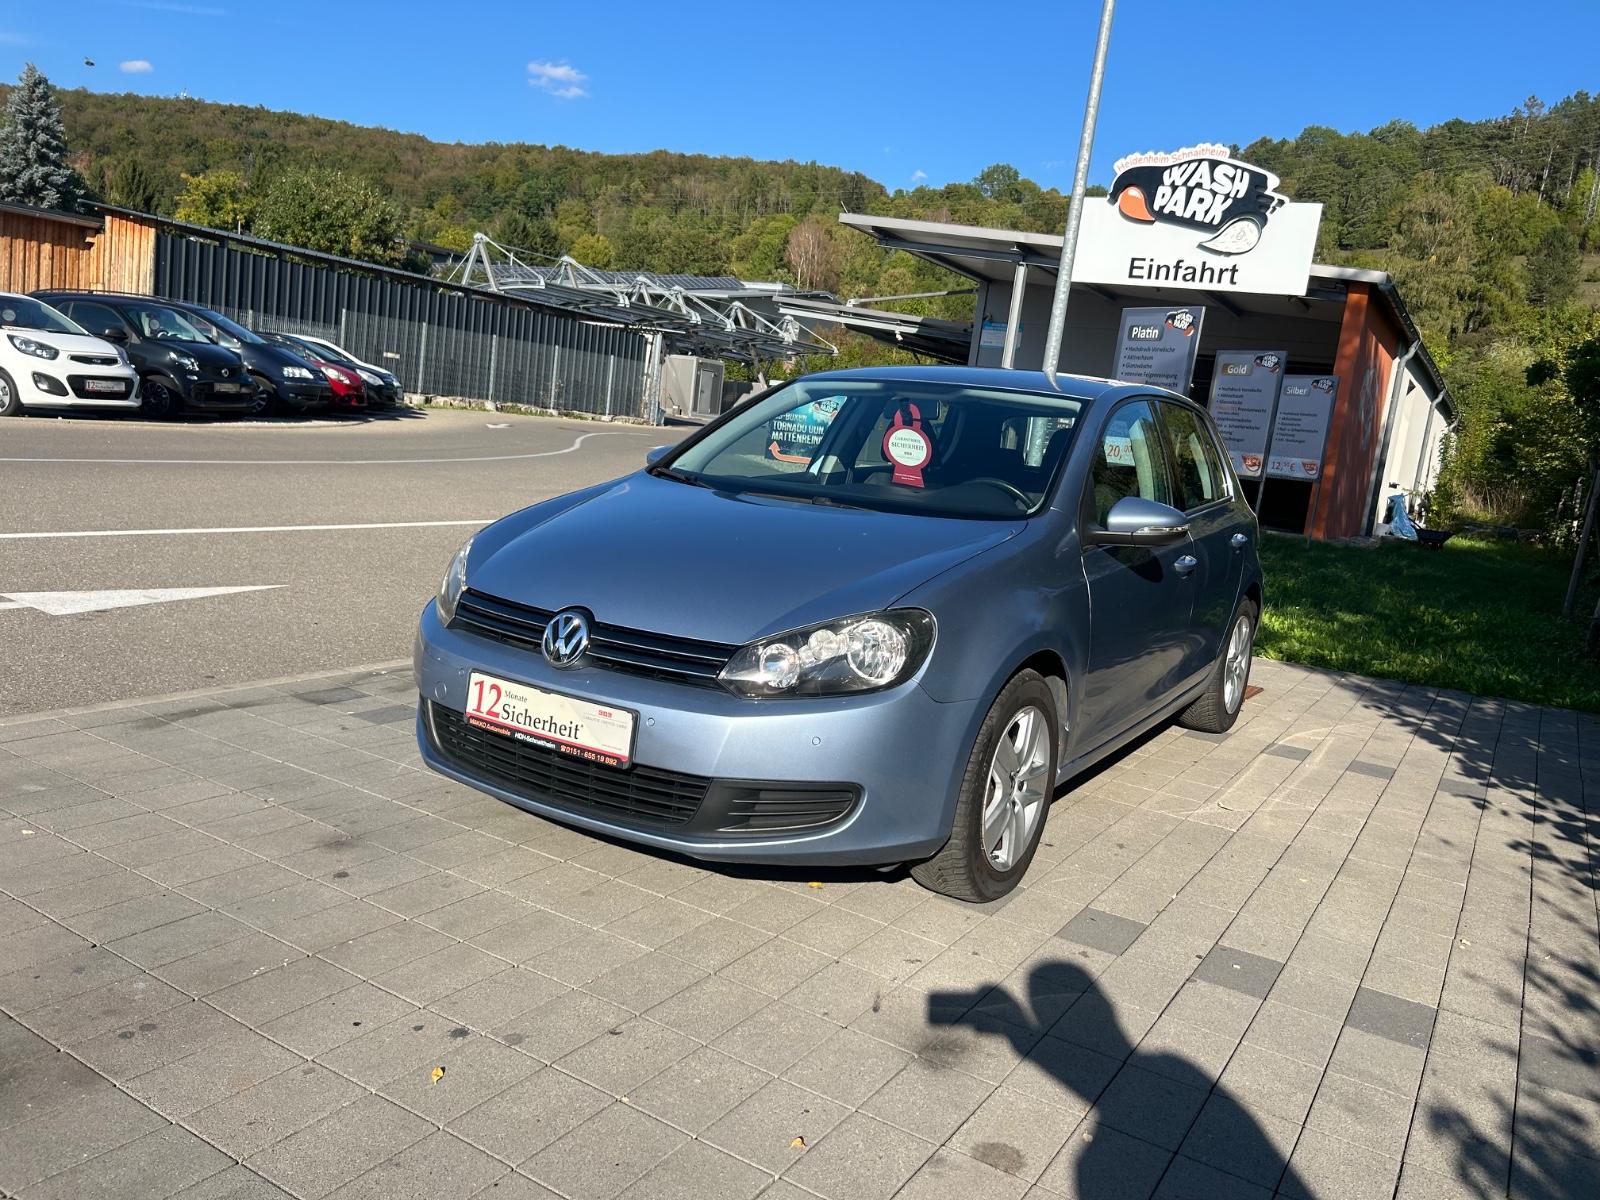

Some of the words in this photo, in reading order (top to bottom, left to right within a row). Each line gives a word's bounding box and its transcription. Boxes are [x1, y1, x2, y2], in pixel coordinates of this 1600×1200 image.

[1116, 155, 1169, 172] Heidenheim
[1171, 147, 1227, 163] Schnaitheim
[1162, 161, 1250, 199] WASH
[1153, 186, 1233, 225] PARK
[1127, 257, 1239, 285] Einfahrt
[1131, 326, 1159, 339] Platin
[1227, 364, 1247, 374] Gold
[1286, 385, 1308, 395] Silber
[472, 680, 502, 719] 12
[504, 689, 528, 703] Monate
[501, 703, 580, 740] Sicherheit
